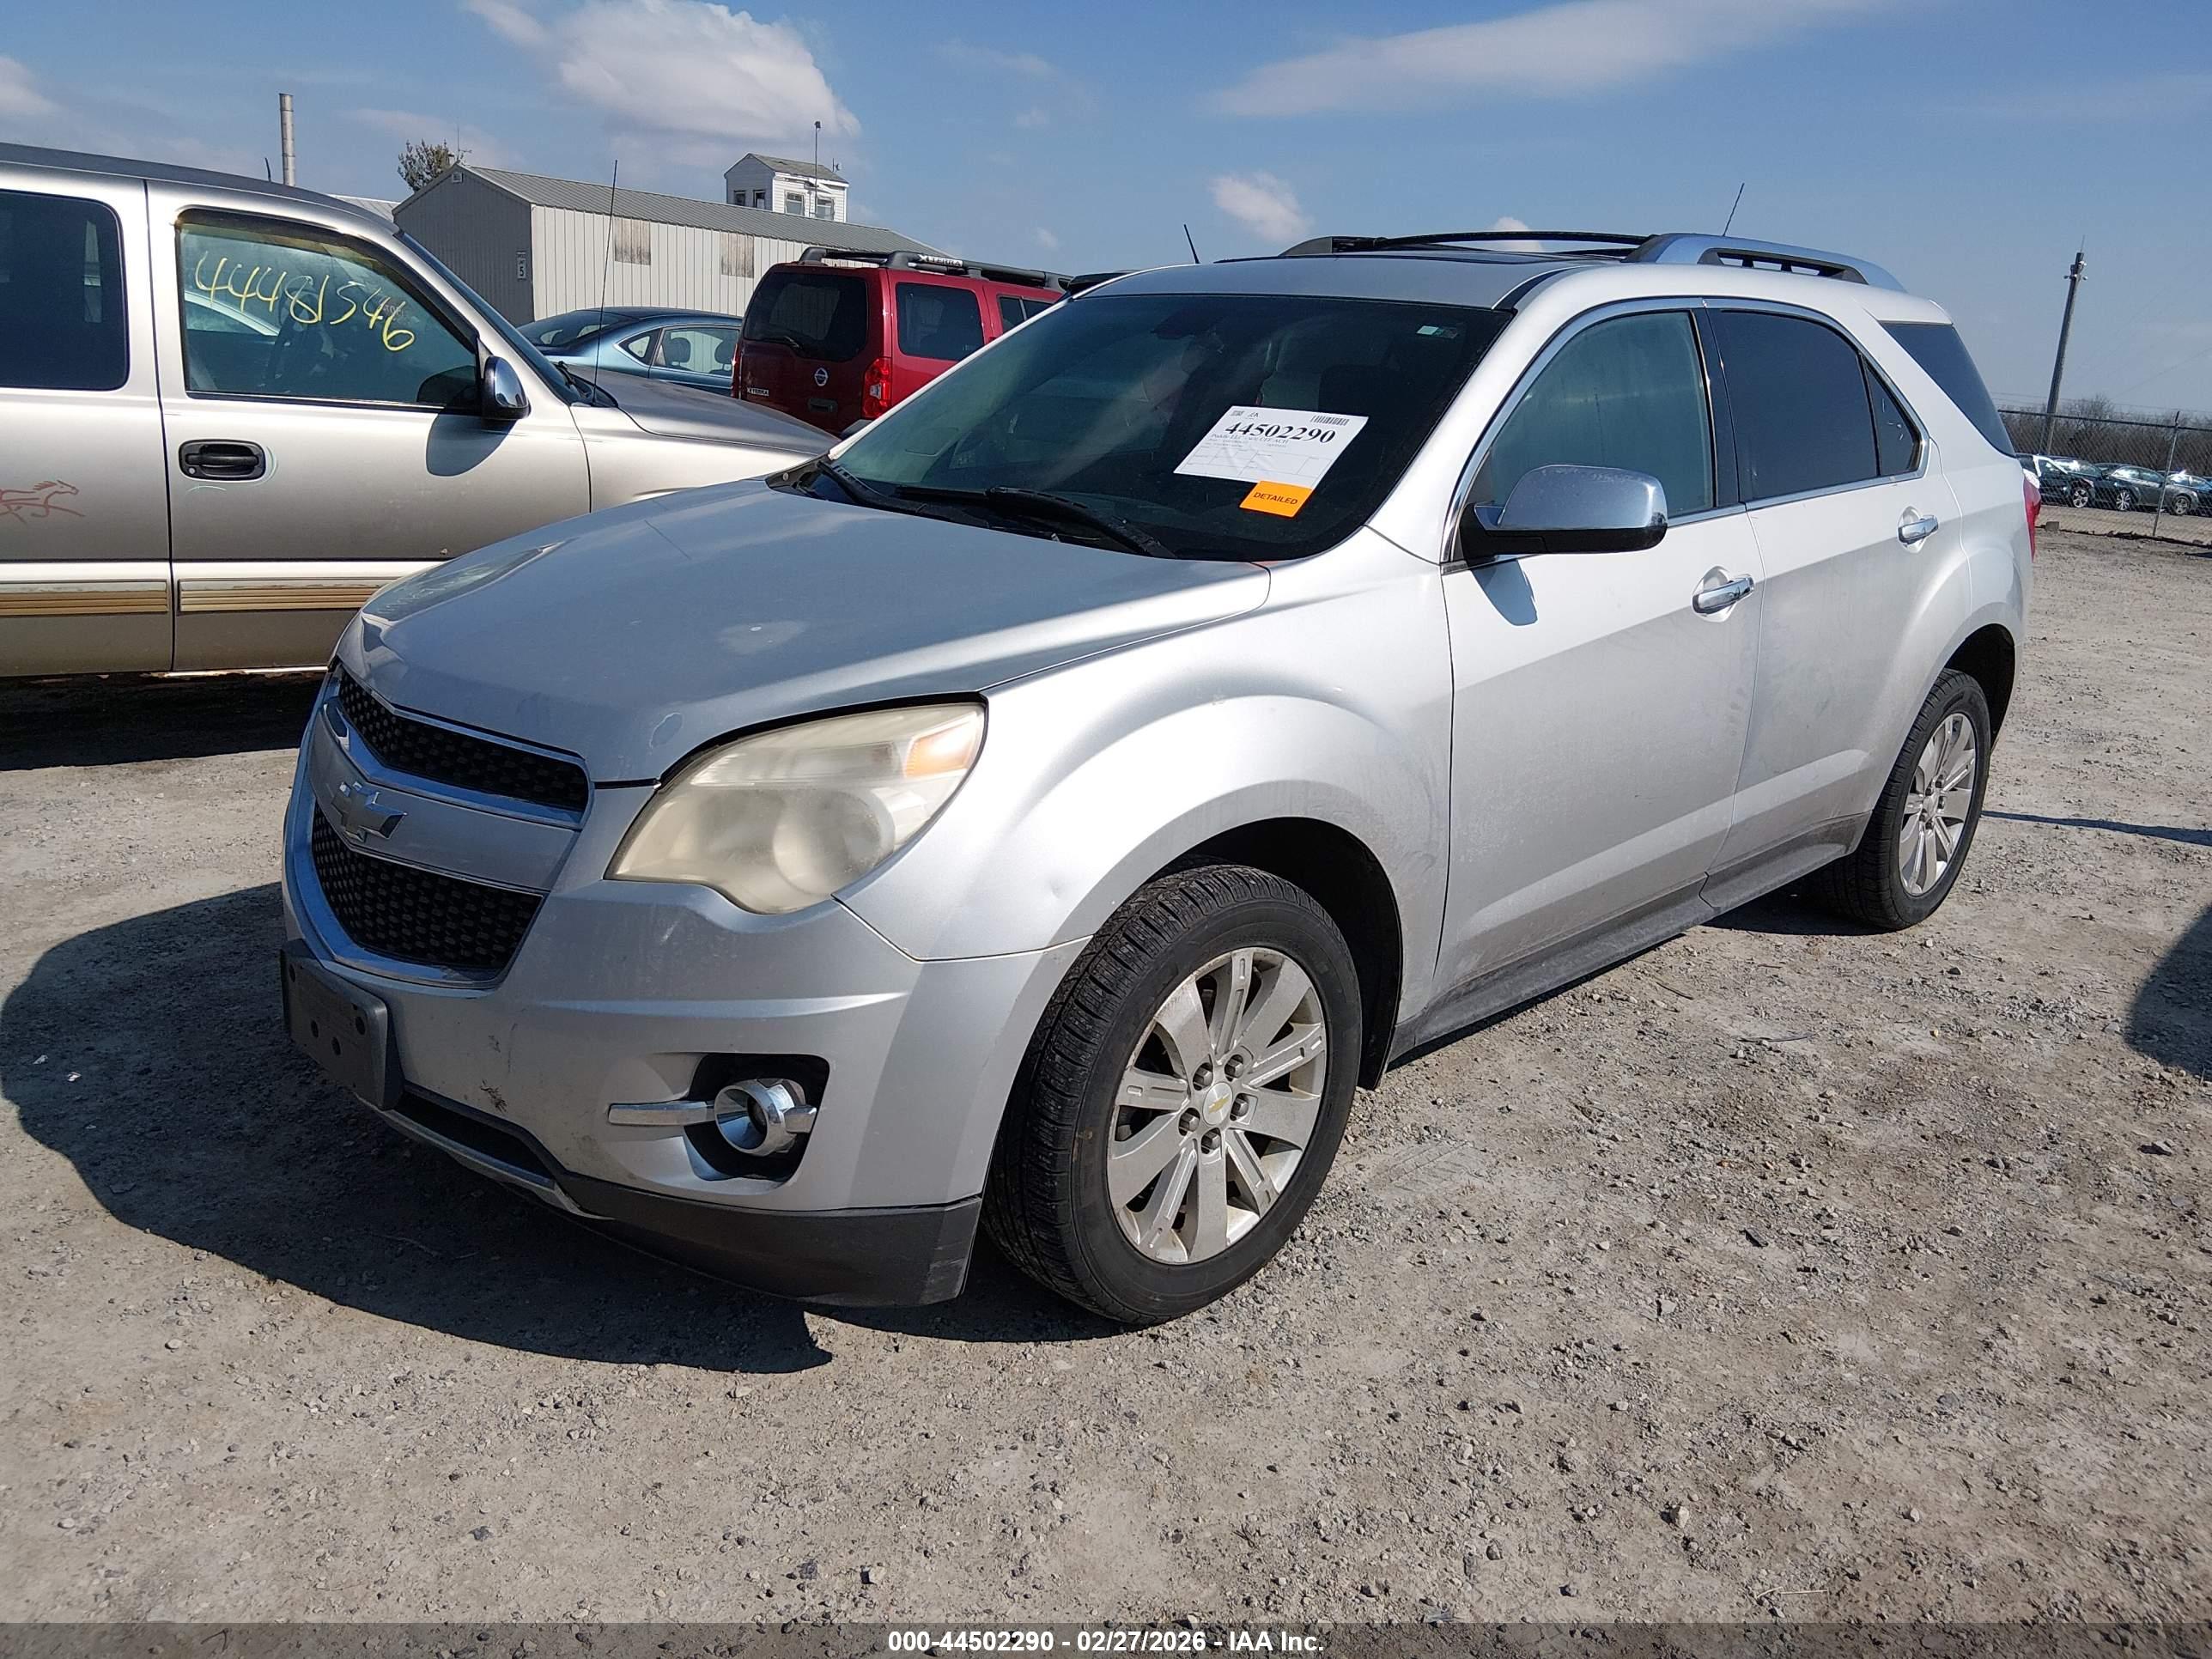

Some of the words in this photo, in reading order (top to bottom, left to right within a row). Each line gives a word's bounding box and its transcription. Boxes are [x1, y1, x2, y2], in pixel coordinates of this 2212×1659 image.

[195, 251, 415, 351] 44481546
[1224, 422, 1336, 444] 44502290
[1253, 491, 1298, 506] DETAILED
